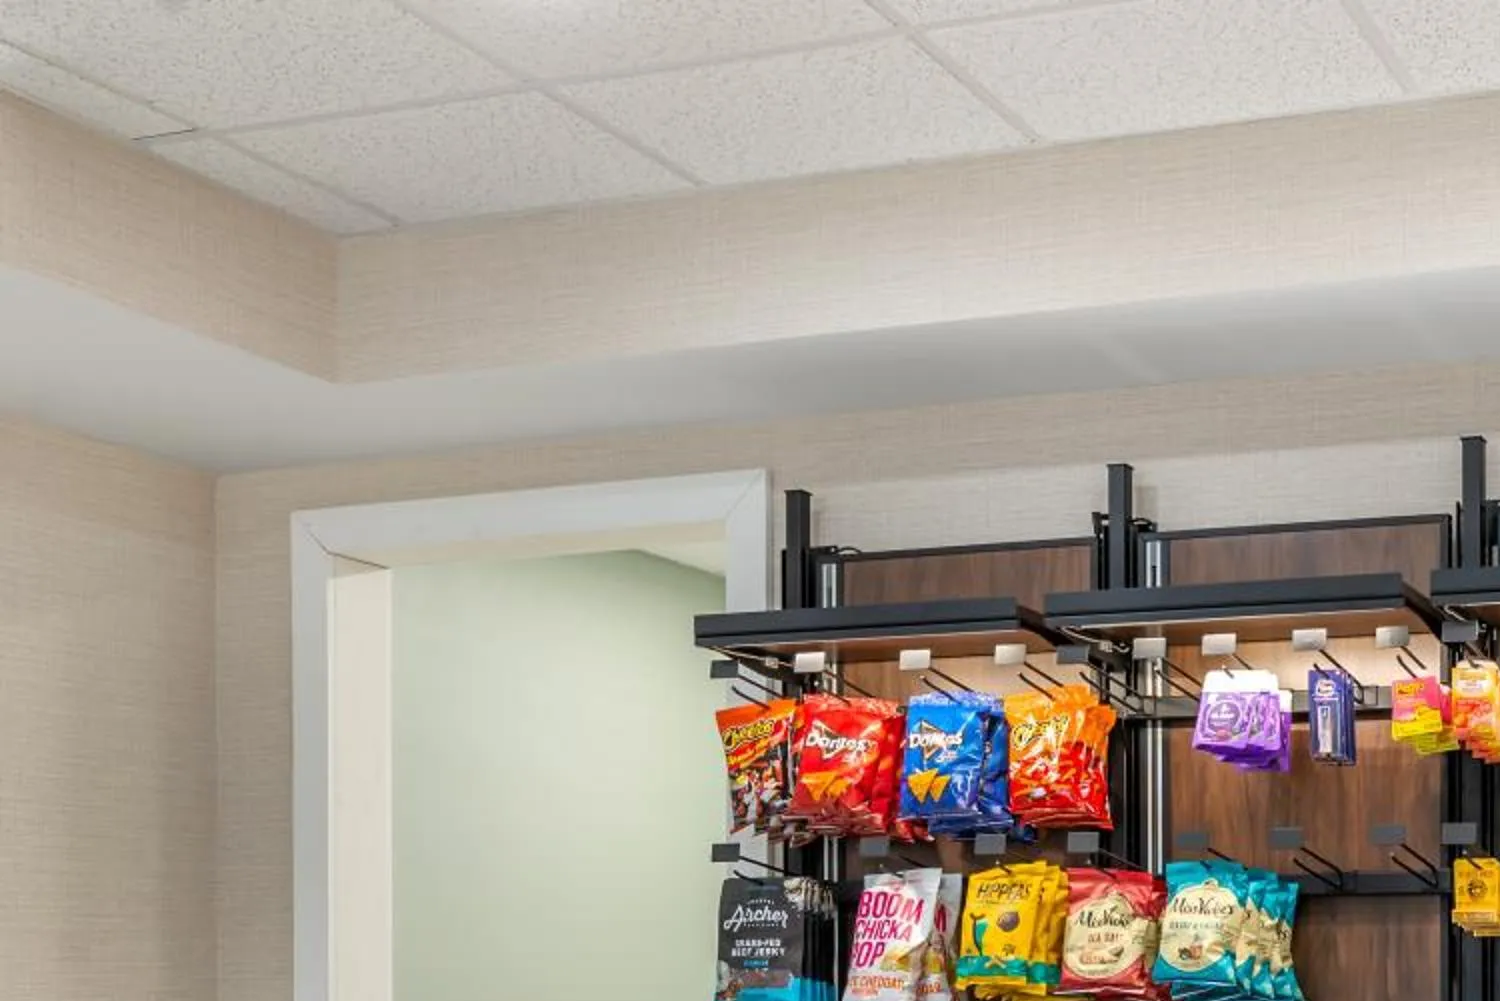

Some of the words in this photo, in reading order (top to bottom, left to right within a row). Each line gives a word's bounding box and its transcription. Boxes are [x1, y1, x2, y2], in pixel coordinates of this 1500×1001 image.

[805, 729, 867, 751] Doritos
[723, 903, 790, 933] Archer
[858, 891, 925, 924] BOOM
